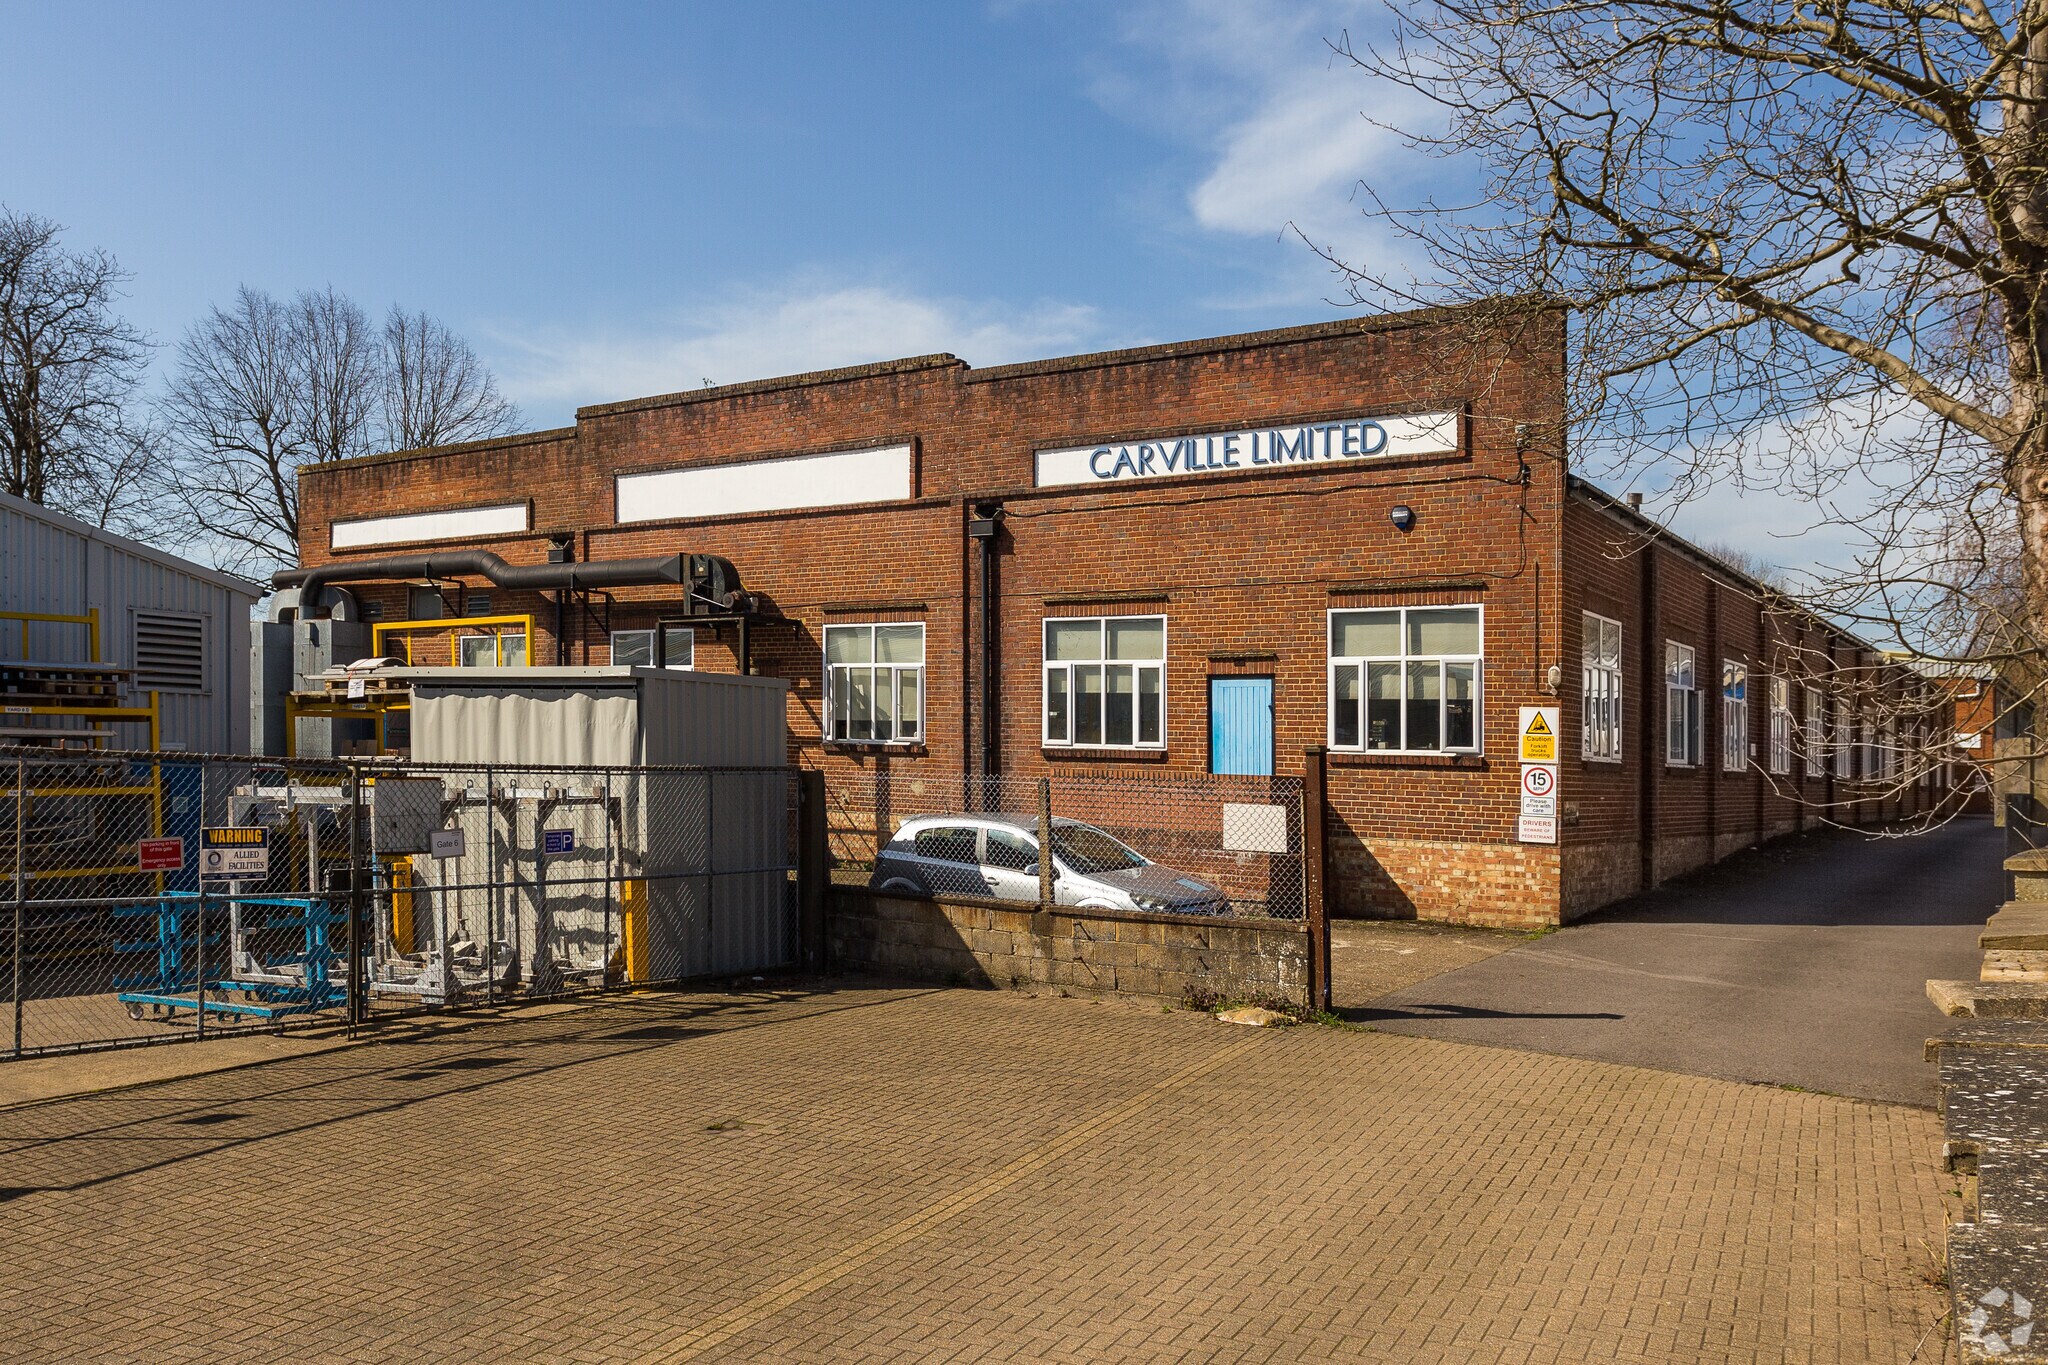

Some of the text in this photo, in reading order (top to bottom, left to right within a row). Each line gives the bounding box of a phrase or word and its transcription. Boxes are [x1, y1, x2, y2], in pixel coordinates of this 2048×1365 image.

[1089, 420, 1387, 479] CARVILLE LIMITED
[1530, 772, 1546, 786] 15
[208, 829, 262, 844] WARNING
[564, 835, 572, 848] P
[234, 850, 260, 859] ALLIED
[228, 862, 264, 870] FACILITIES
